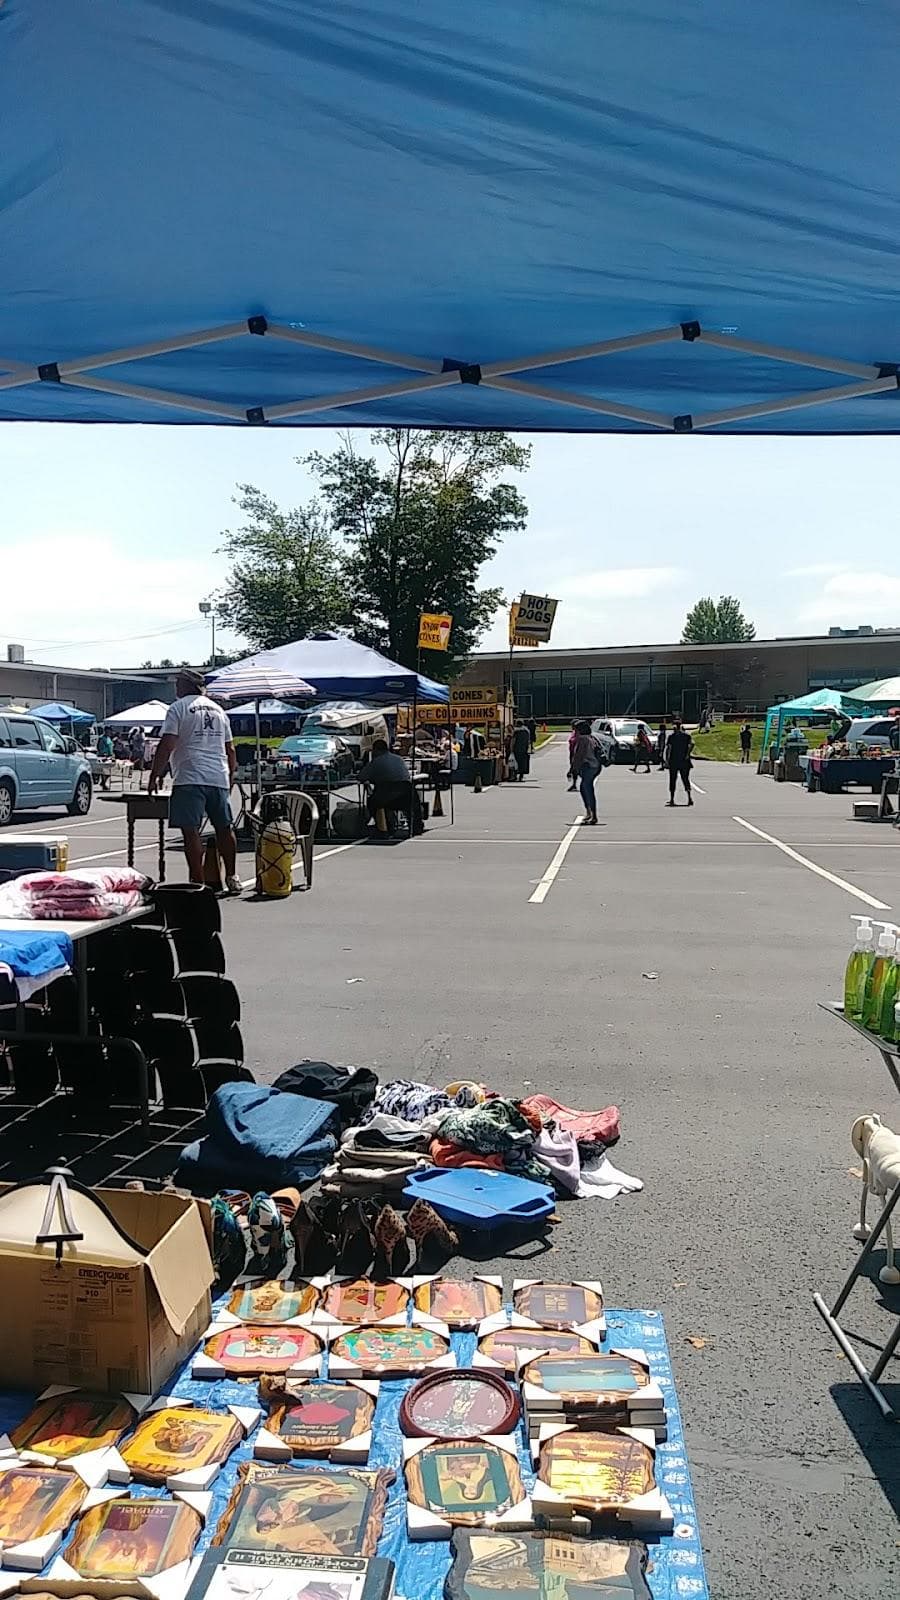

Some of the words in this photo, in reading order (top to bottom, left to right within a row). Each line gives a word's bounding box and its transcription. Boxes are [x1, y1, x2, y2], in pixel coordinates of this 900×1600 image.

[527, 598, 551, 611] HOT
[517, 607, 552, 624] DOGS
[422, 621, 440, 632] SNOW
[419, 632, 440, 643] CONES
[452, 690, 483, 701] CONES
[416, 709, 433, 720] CE
[435, 708, 458, 719] COD
[460, 707, 495, 719] DRINKS
[285, 1556, 321, 1566] JOHN
[323, 1559, 359, 1568] POPE
